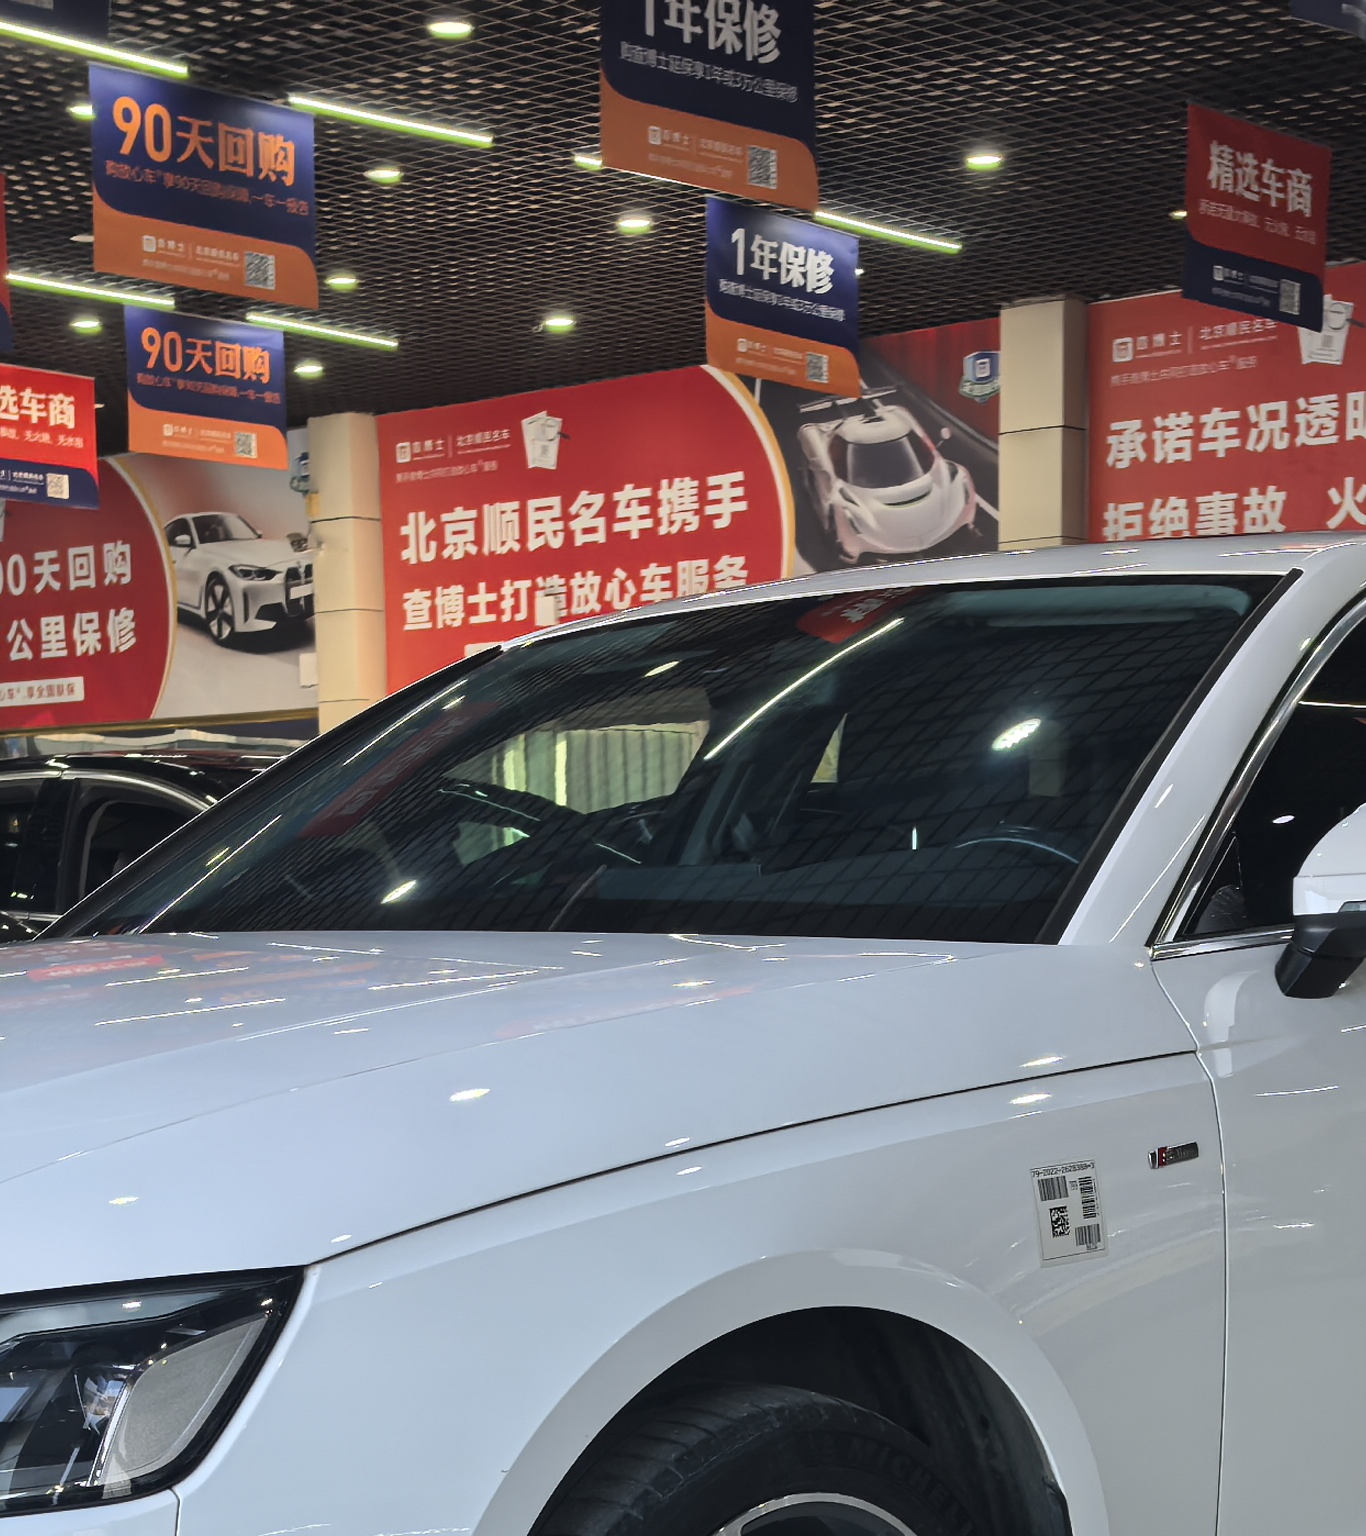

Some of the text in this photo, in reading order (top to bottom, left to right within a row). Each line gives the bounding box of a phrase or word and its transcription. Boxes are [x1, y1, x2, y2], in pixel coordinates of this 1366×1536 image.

[113, 96, 295, 187] 90天回购
[1207, 140, 1313, 218] 精选车商
[731, 227, 835, 294] 1年保修
[141, 327, 271, 384] 90天回购
[400, 471, 749, 565] 北京顺民名车携手
[1102, 486, 1288, 541] 拒绝事故
